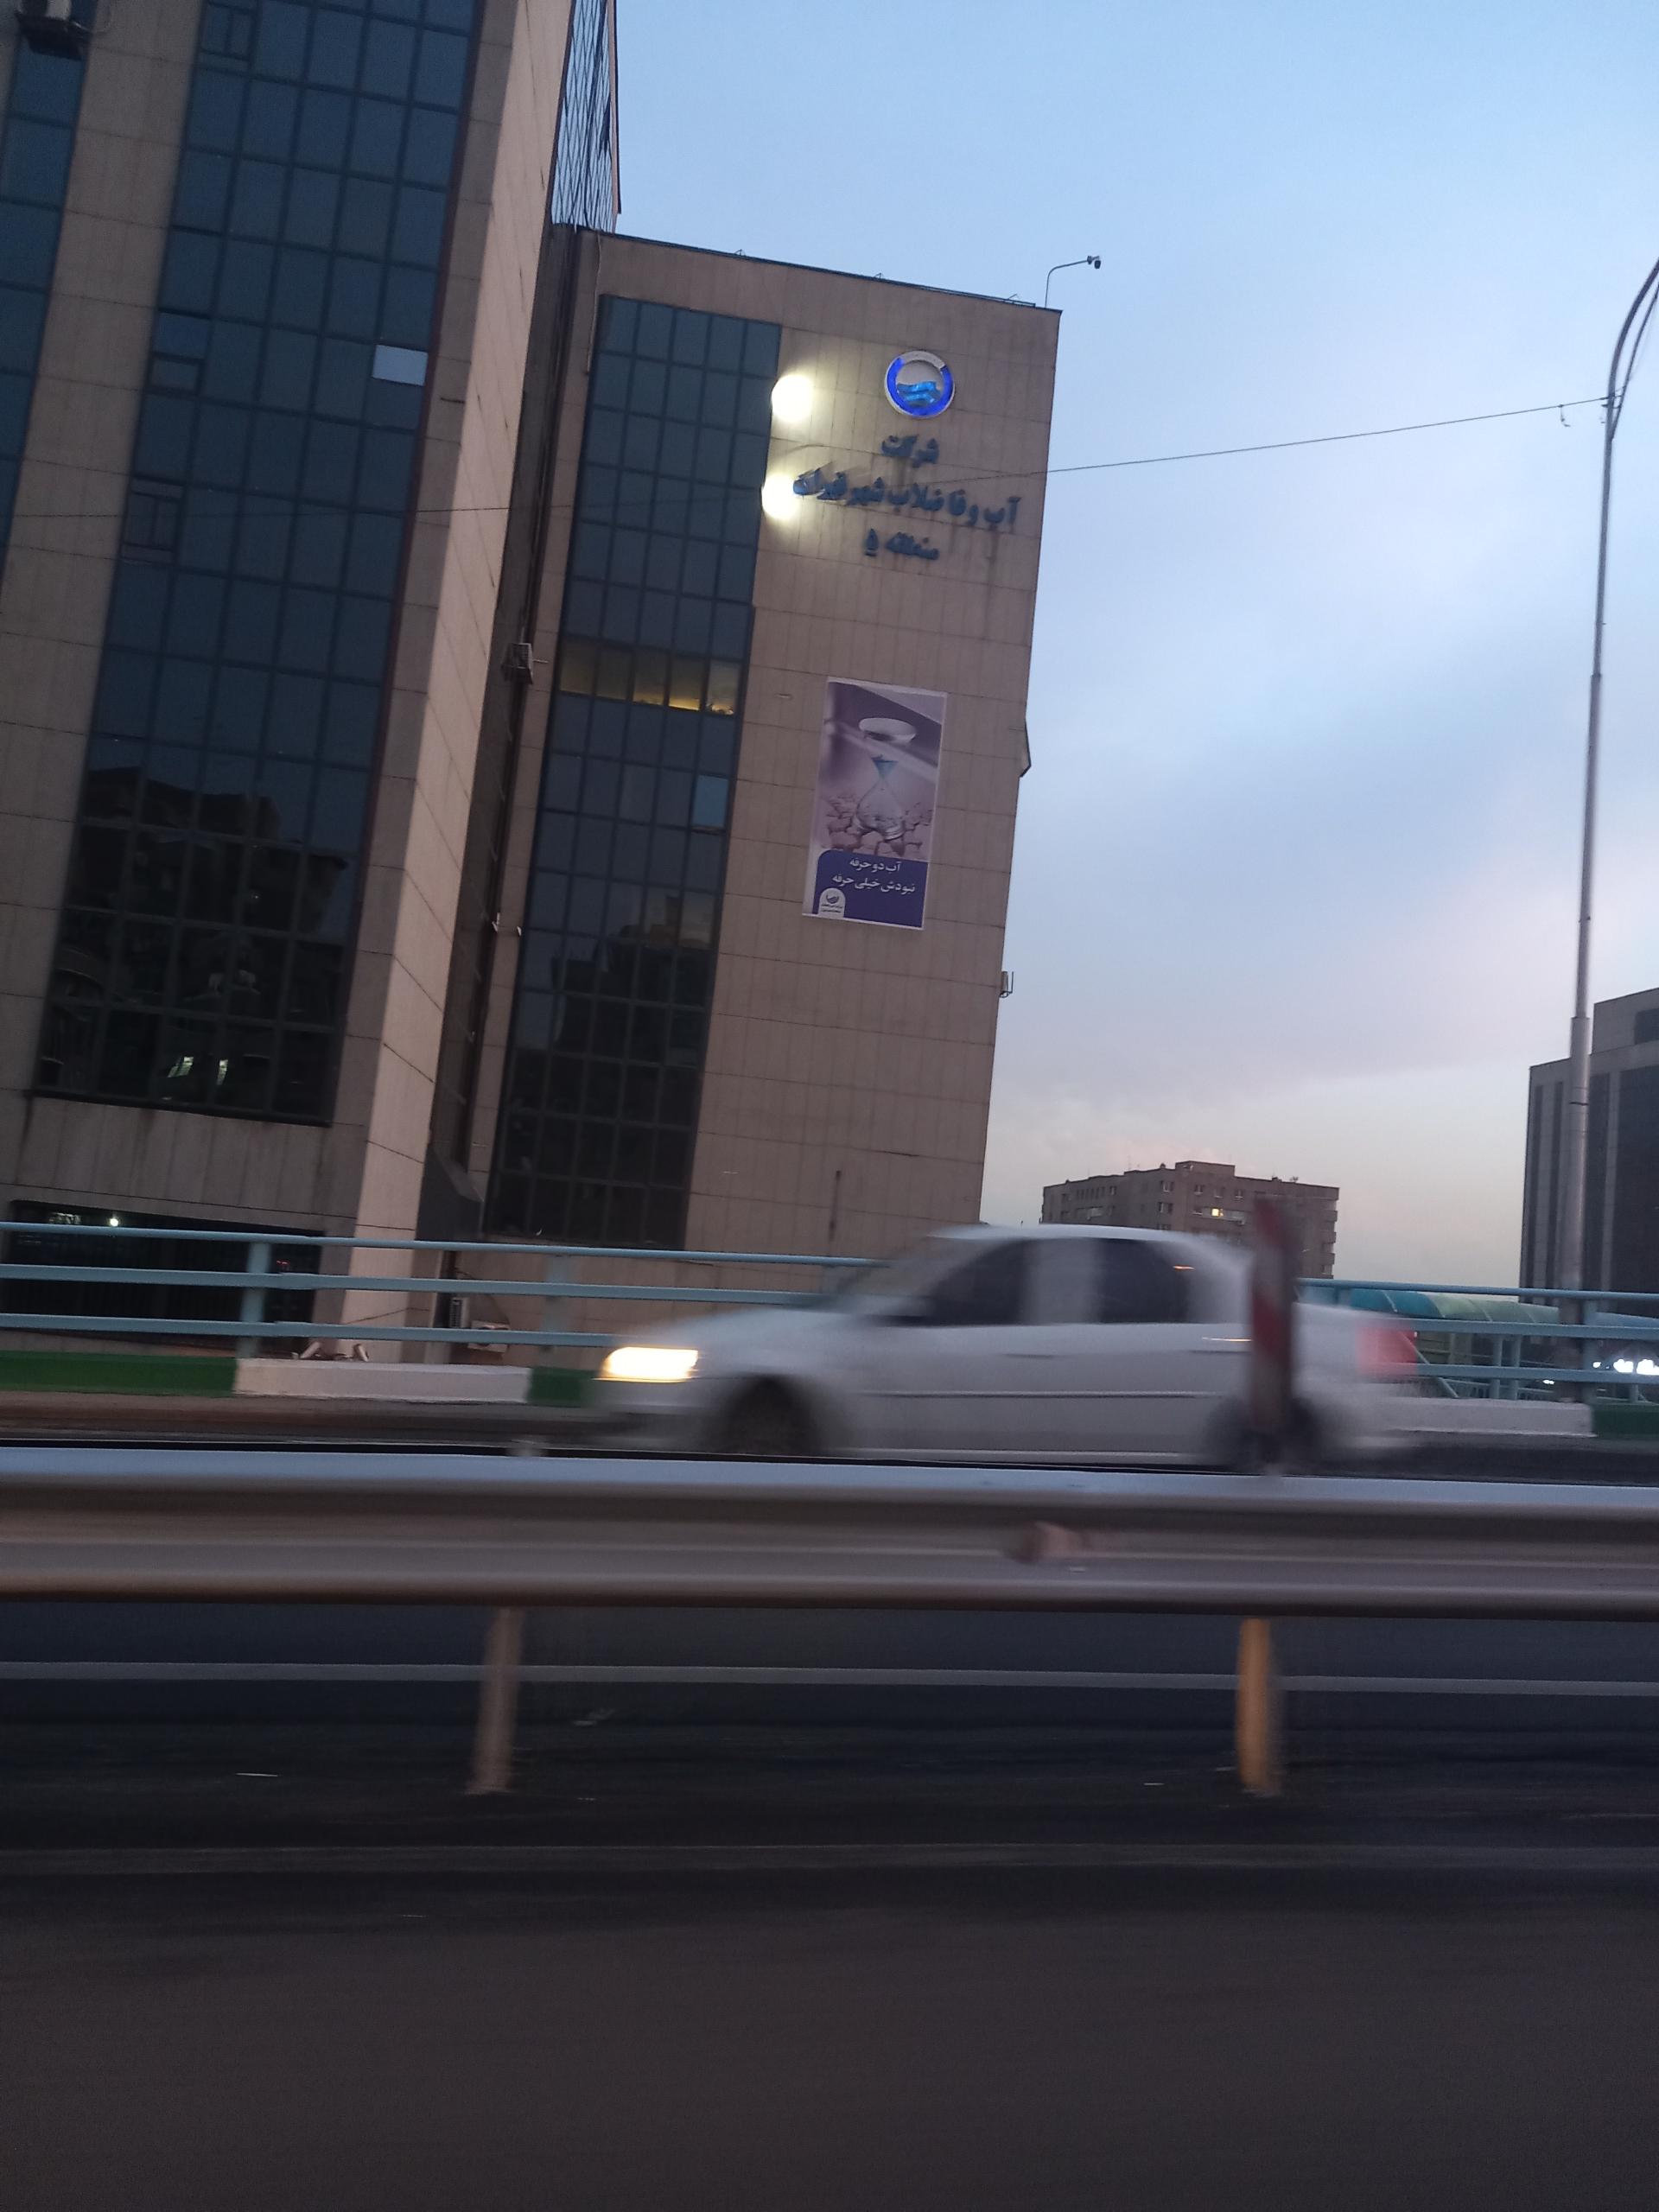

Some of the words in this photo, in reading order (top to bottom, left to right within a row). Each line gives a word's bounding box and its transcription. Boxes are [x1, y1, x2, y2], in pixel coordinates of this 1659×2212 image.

[881, 435, 939, 468] شرکت
[887, 482, 966, 516] فاضلاب
[964, 504, 979, 526] و
[982, 496, 1021, 531] آب
[886, 531, 939, 560] منطقه
[849, 857, 871, 870] حرفه
[871, 862, 885, 872] دو
[885, 861, 902, 874] آب
[832, 872, 855, 887] حرفه
[855, 876, 880, 890] خیلی
[880, 880, 916, 895] نبودش
